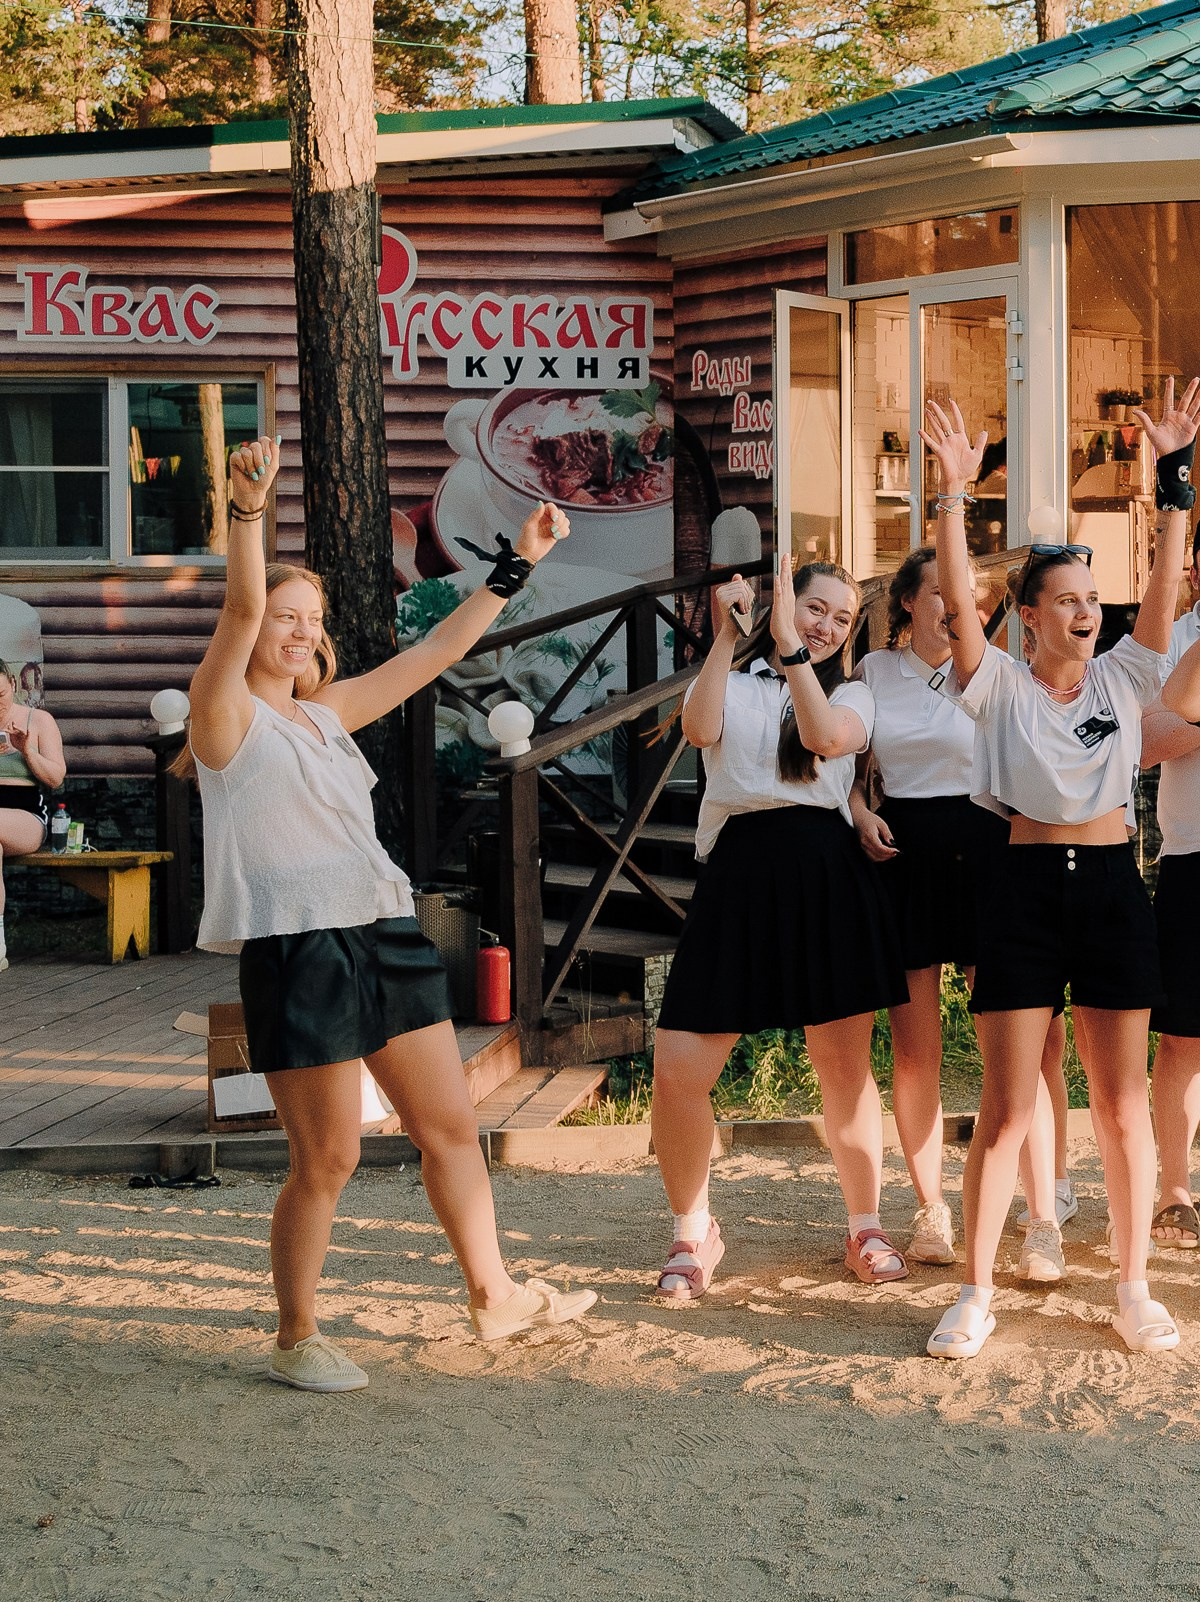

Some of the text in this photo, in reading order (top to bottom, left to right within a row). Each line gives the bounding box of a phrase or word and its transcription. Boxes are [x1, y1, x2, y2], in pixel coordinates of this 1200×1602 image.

[23, 270, 216, 341] Квас
[464, 355, 641, 386] кухня
[691, 351, 751, 393] Рады
[732, 394, 774, 430] Вас
[728, 444, 775, 476] вид
